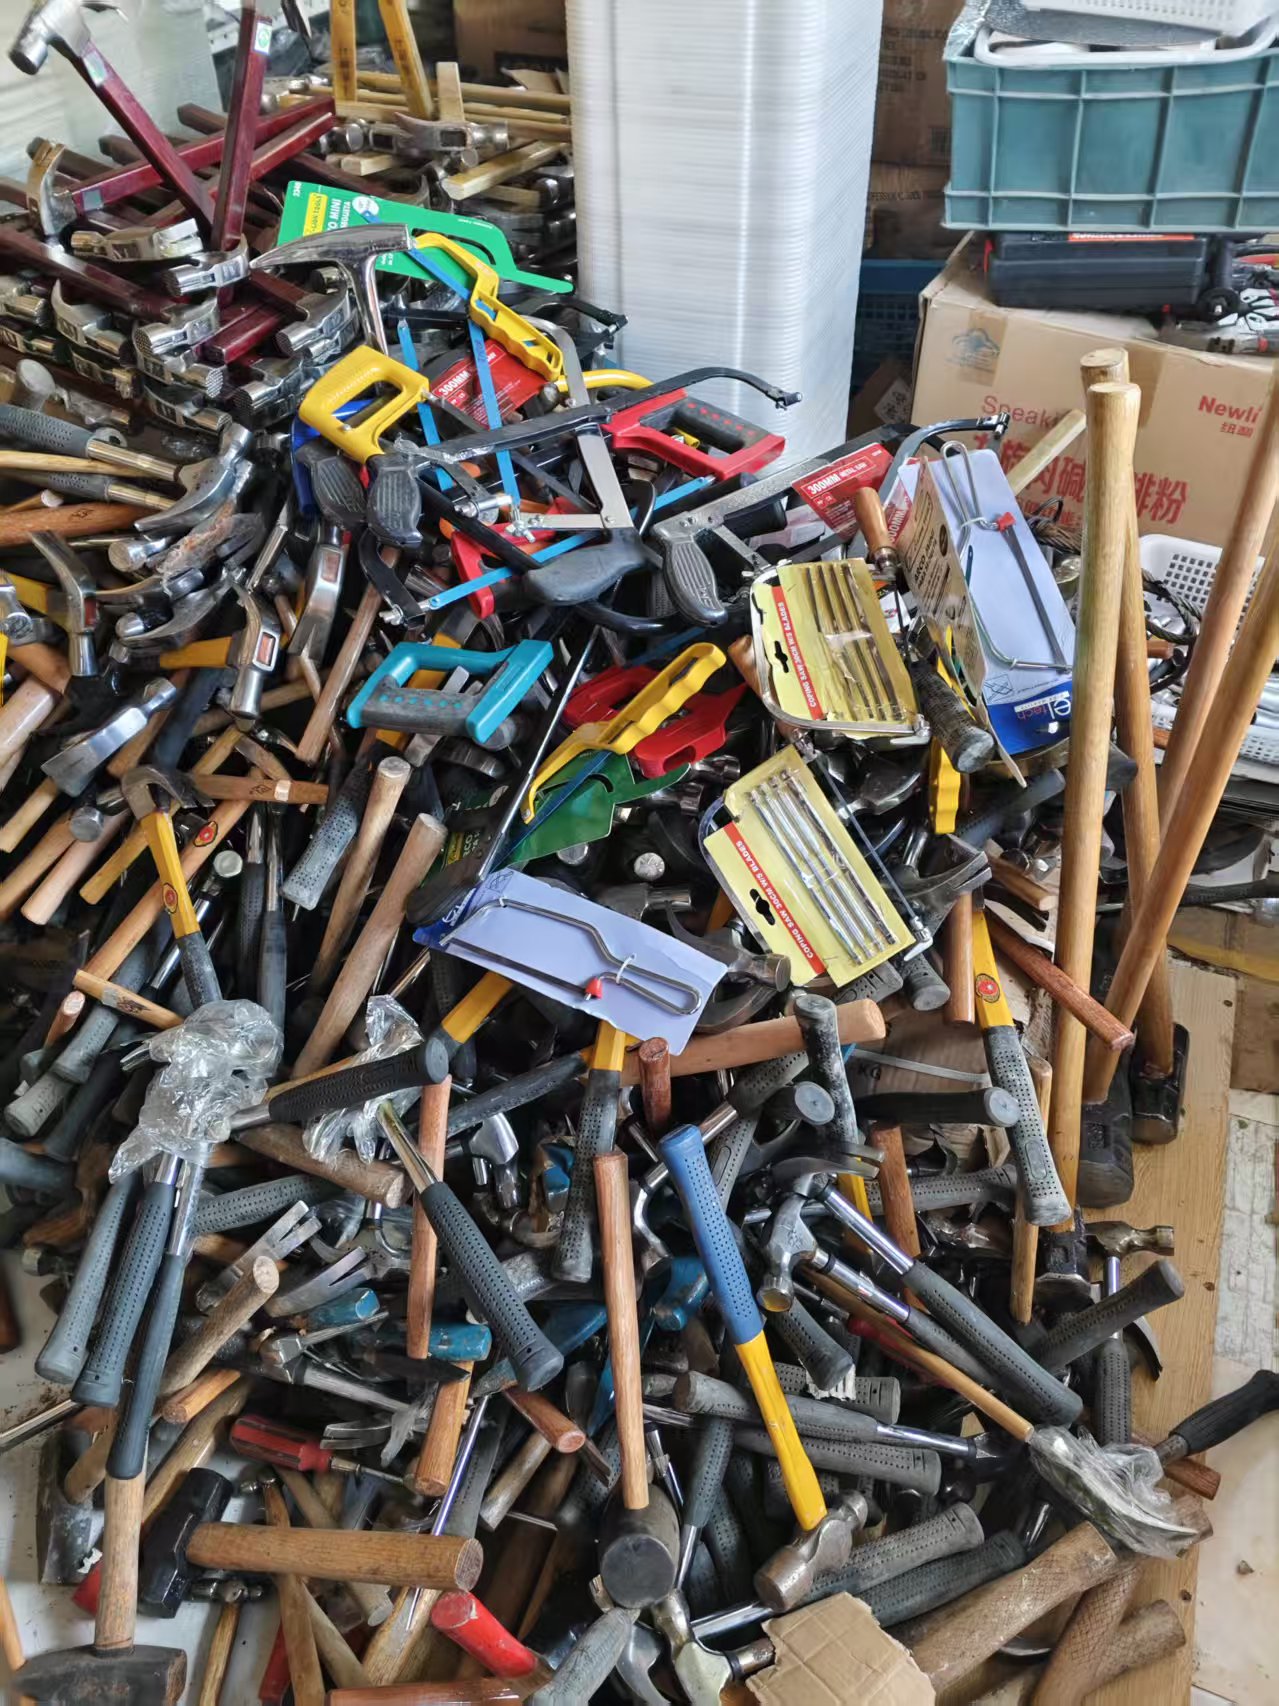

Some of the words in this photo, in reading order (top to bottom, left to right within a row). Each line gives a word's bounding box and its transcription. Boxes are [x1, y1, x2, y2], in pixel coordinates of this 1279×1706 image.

[329, 198, 341, 220] MINI
[437, 369, 472, 397] 300MM
[806, 472, 842, 496] 300MM
[776, 600, 793, 632] BLADES
[796, 663, 808, 682] SAW
[802, 680, 817, 708] COPING
[734, 838, 760, 873] BLADES
[765, 886, 784, 911] 30CM
[779, 908, 796, 929] SAW
[791, 927, 815, 960] COPING
